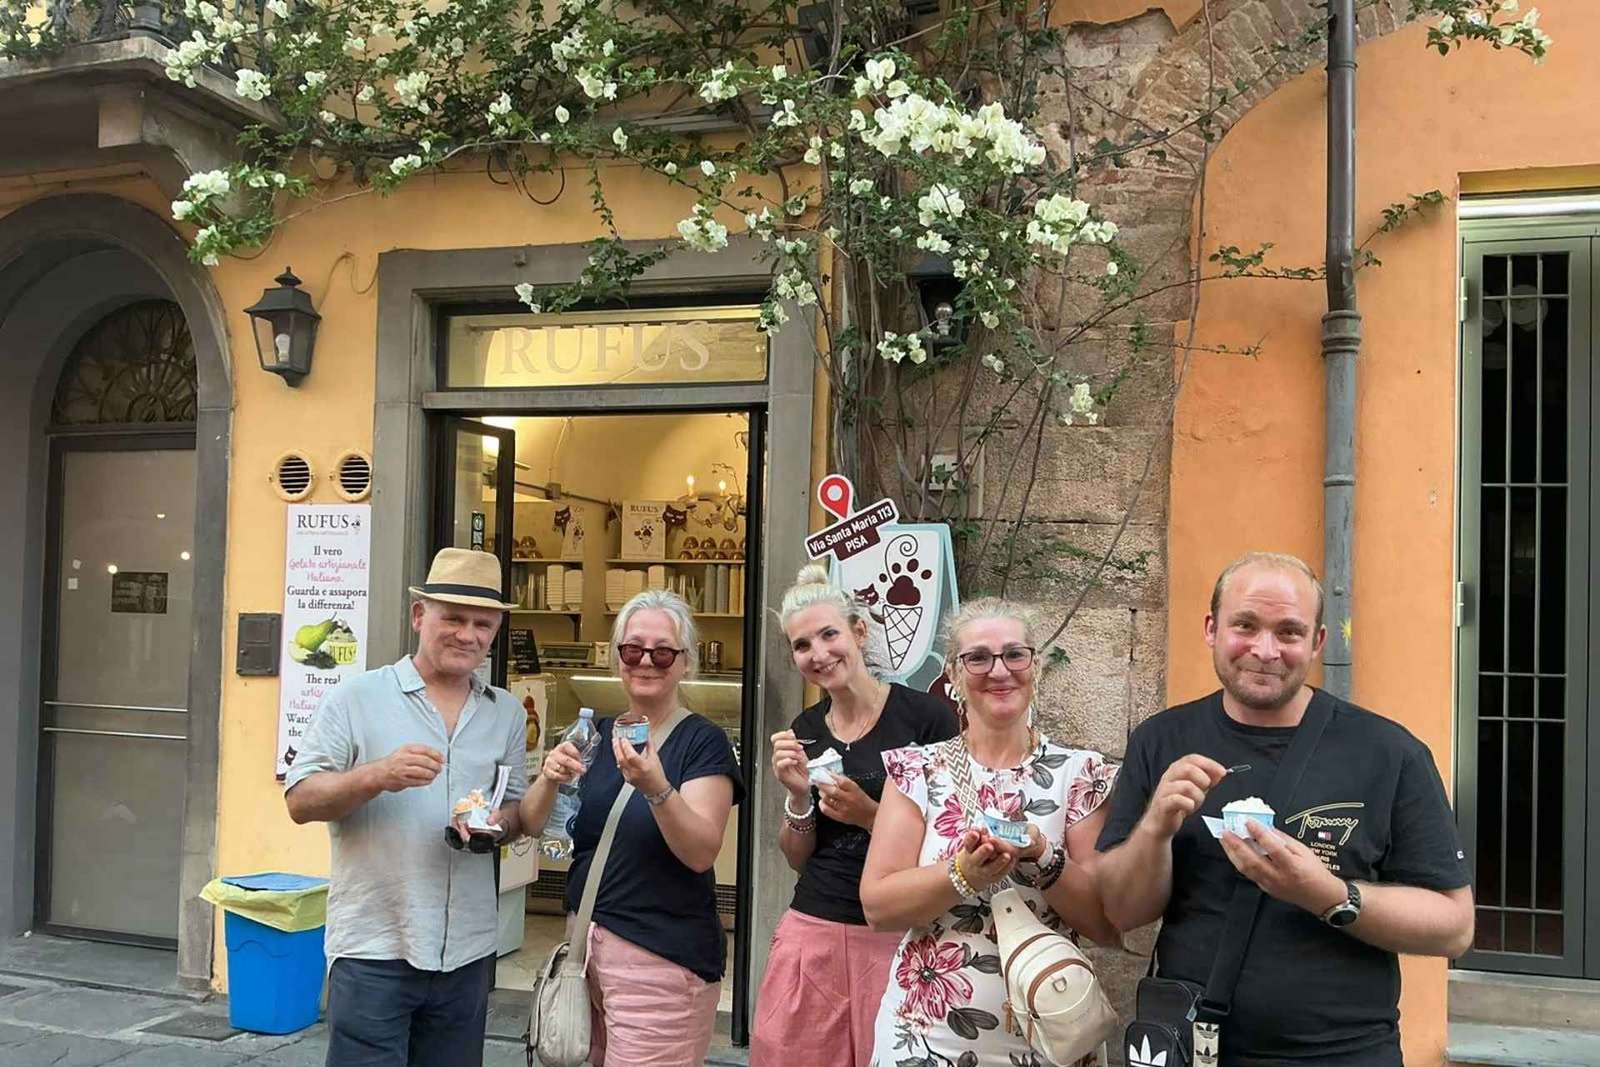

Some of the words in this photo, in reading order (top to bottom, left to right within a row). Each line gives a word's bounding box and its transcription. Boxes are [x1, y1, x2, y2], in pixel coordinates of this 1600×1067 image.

[500, 320, 710, 375] RUFUS
[630, 504, 658, 513] RUFUS
[297, 514, 349, 528] RUFUS
[810, 540, 826, 553] Via
[825, 528, 852, 546] Santa
[851, 515, 878, 533] Maria
[877, 505, 893, 520] 113
[314, 545, 321, 556] Il
[323, 548, 343, 556] vero
[845, 535, 868, 553] PISA
[287, 585, 319, 596] Guarda
[321, 588, 327, 596] e
[329, 588, 367, 600] assapora
[298, 599, 306, 609] la
[308, 599, 355, 610] differenza!
[306, 673, 322, 684] The
[1285, 802, 1365, 845] Tommy
[1310, 842, 1336, 850] LONDON
